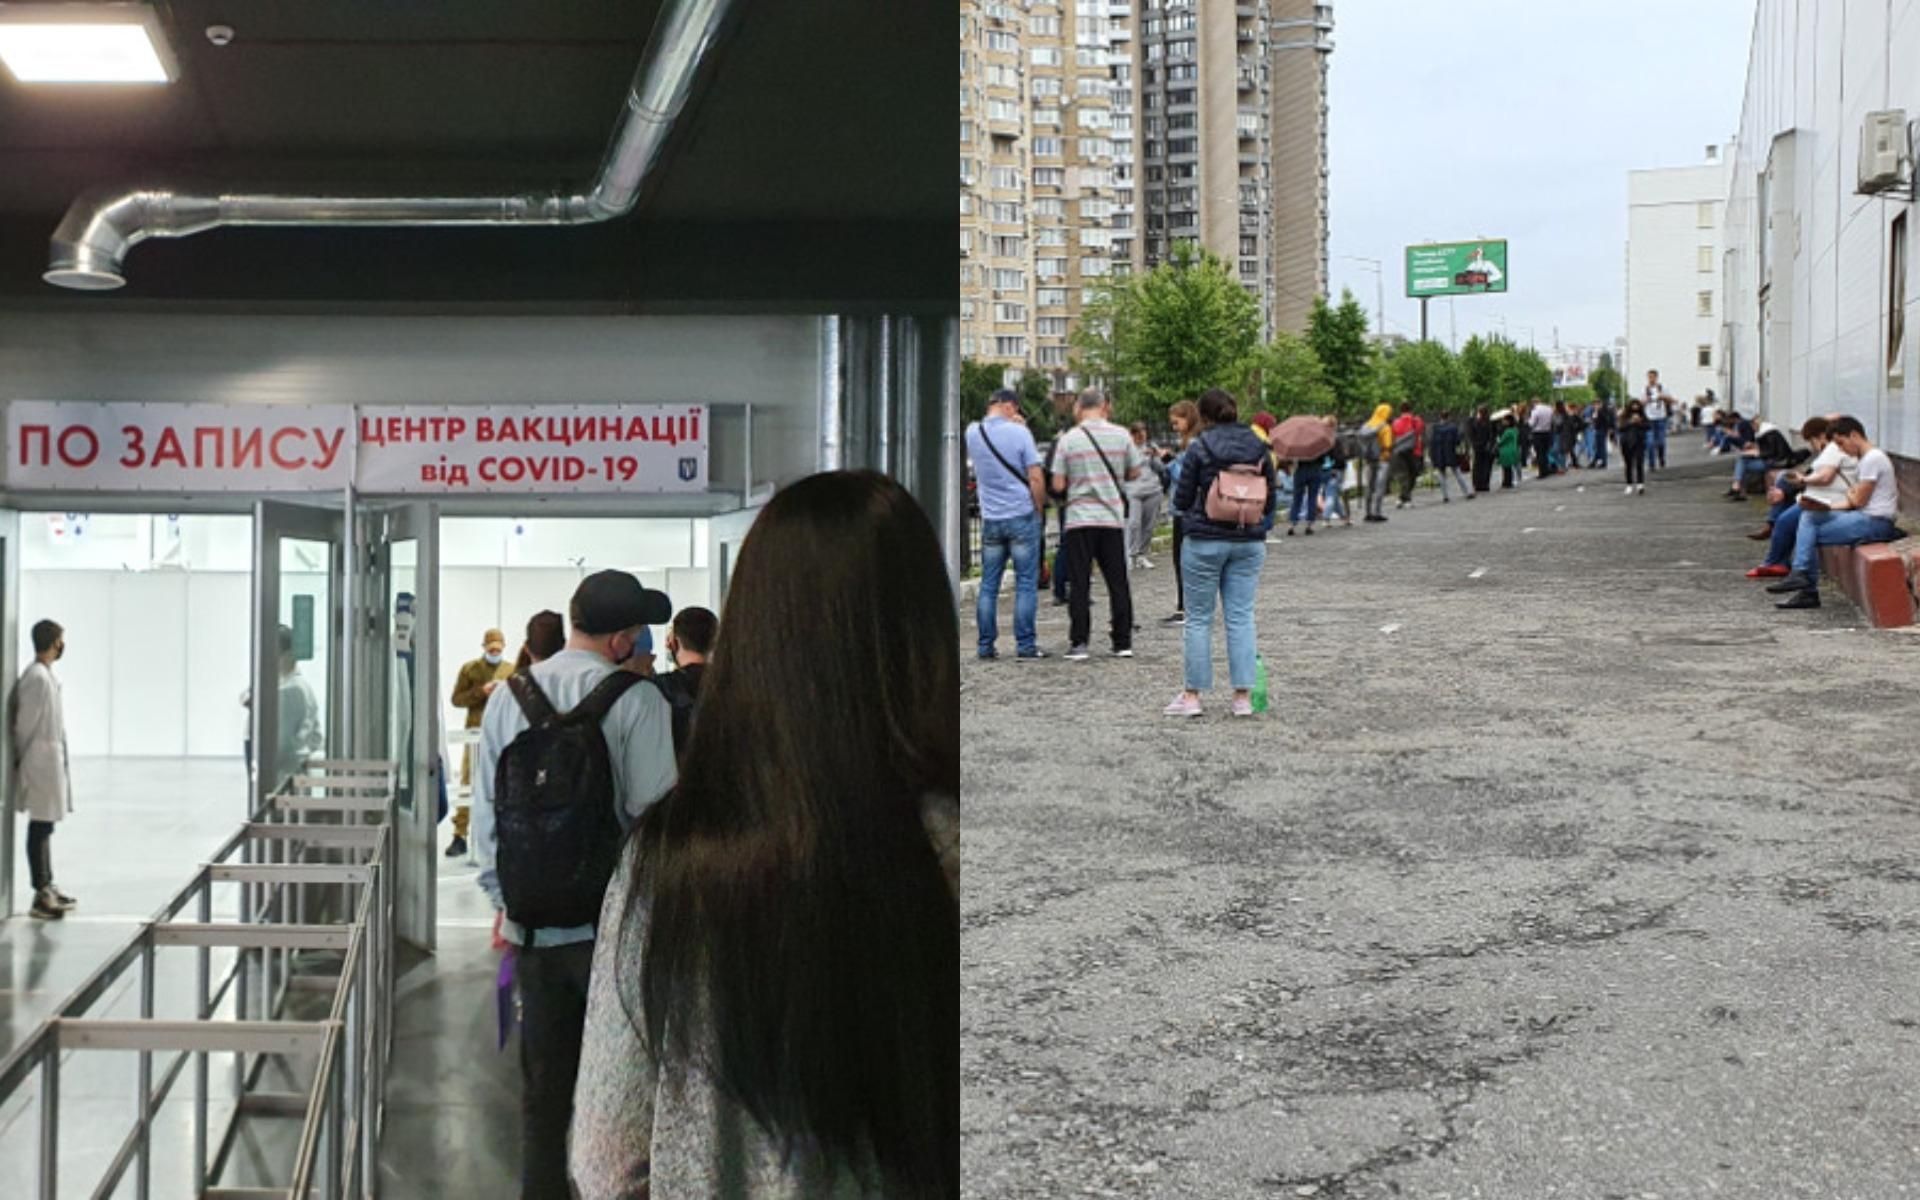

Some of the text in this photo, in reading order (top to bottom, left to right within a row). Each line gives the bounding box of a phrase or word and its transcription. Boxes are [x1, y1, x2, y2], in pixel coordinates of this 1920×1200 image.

[360, 408, 702, 447] ЦЕНТР ВАКЦИНАЦІЇ
[19, 425, 344, 471] ПО ЗАПИСУ
[420, 455, 640, 487] від COVID-19
